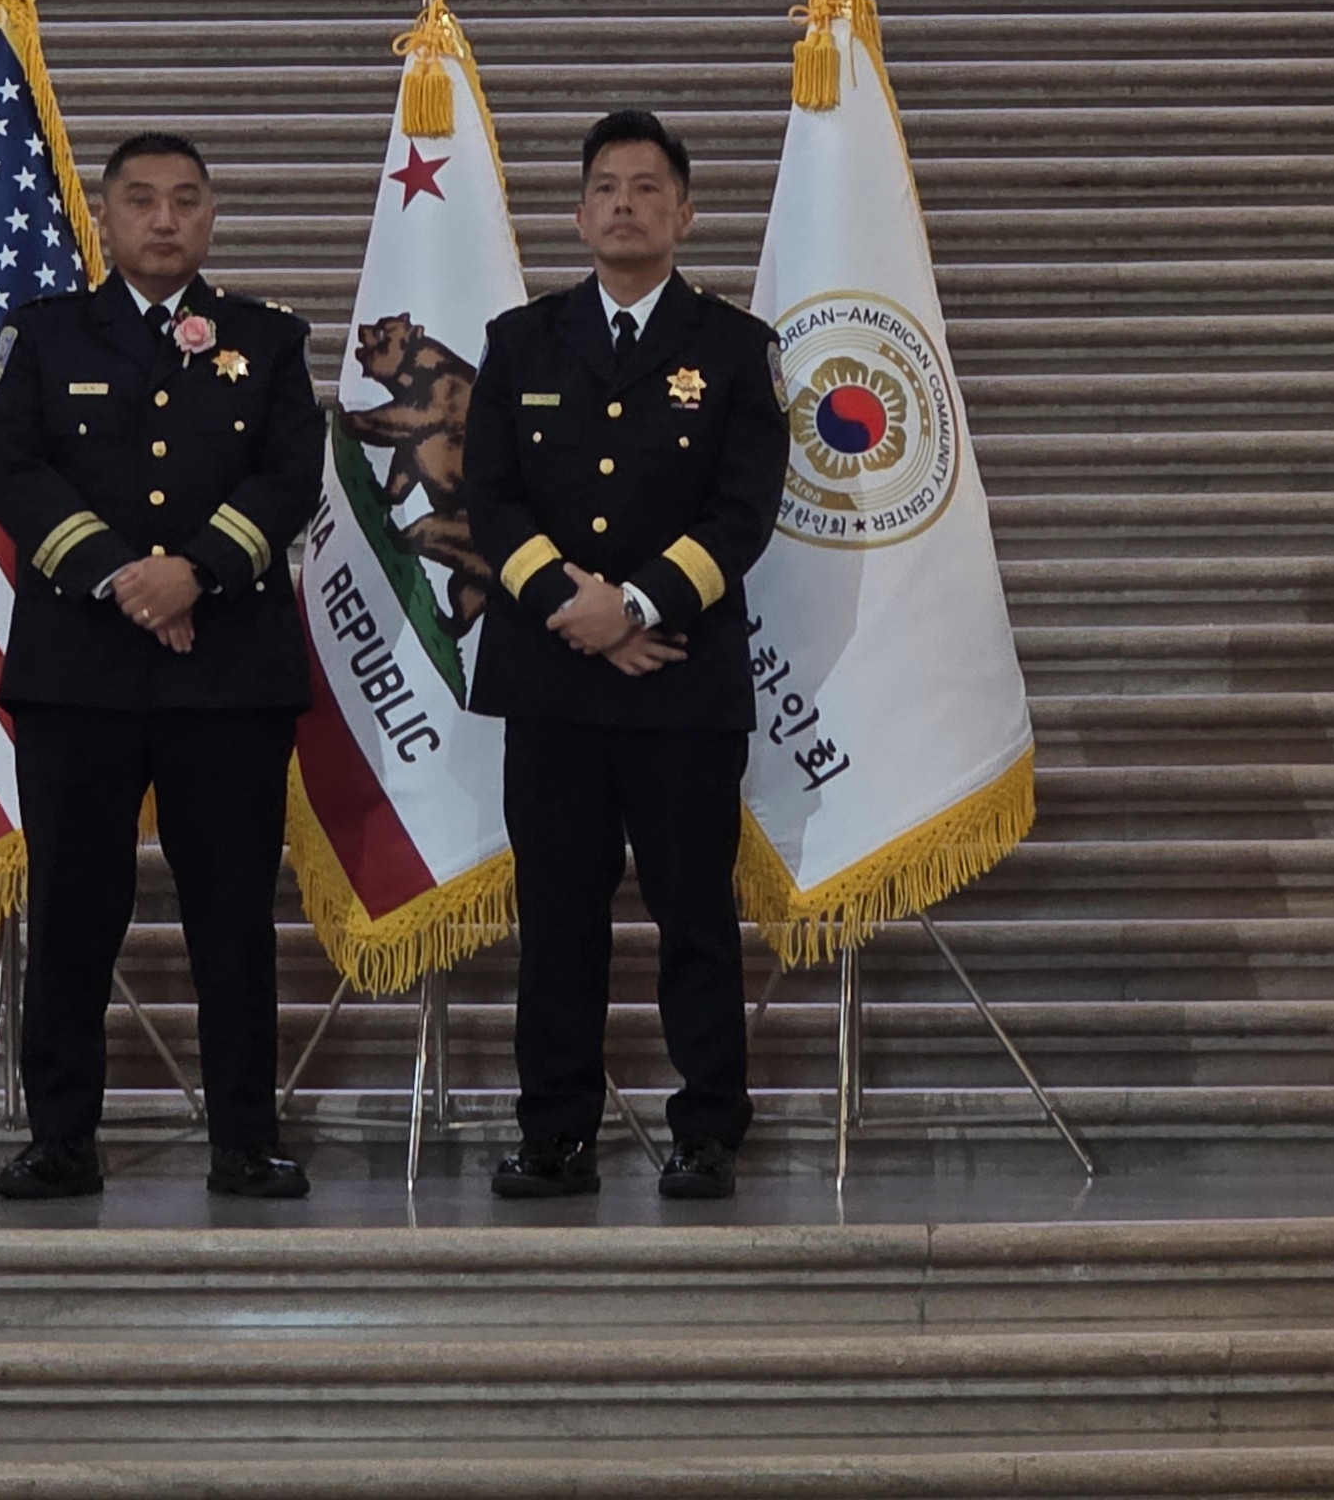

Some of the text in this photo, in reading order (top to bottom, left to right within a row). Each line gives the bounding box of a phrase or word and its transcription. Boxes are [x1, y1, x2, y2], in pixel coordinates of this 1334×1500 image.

[779, 306, 950, 531] OREAN-AMERICAN COMMUNITY CENTER
[321, 562, 441, 763] REPUBLIC
